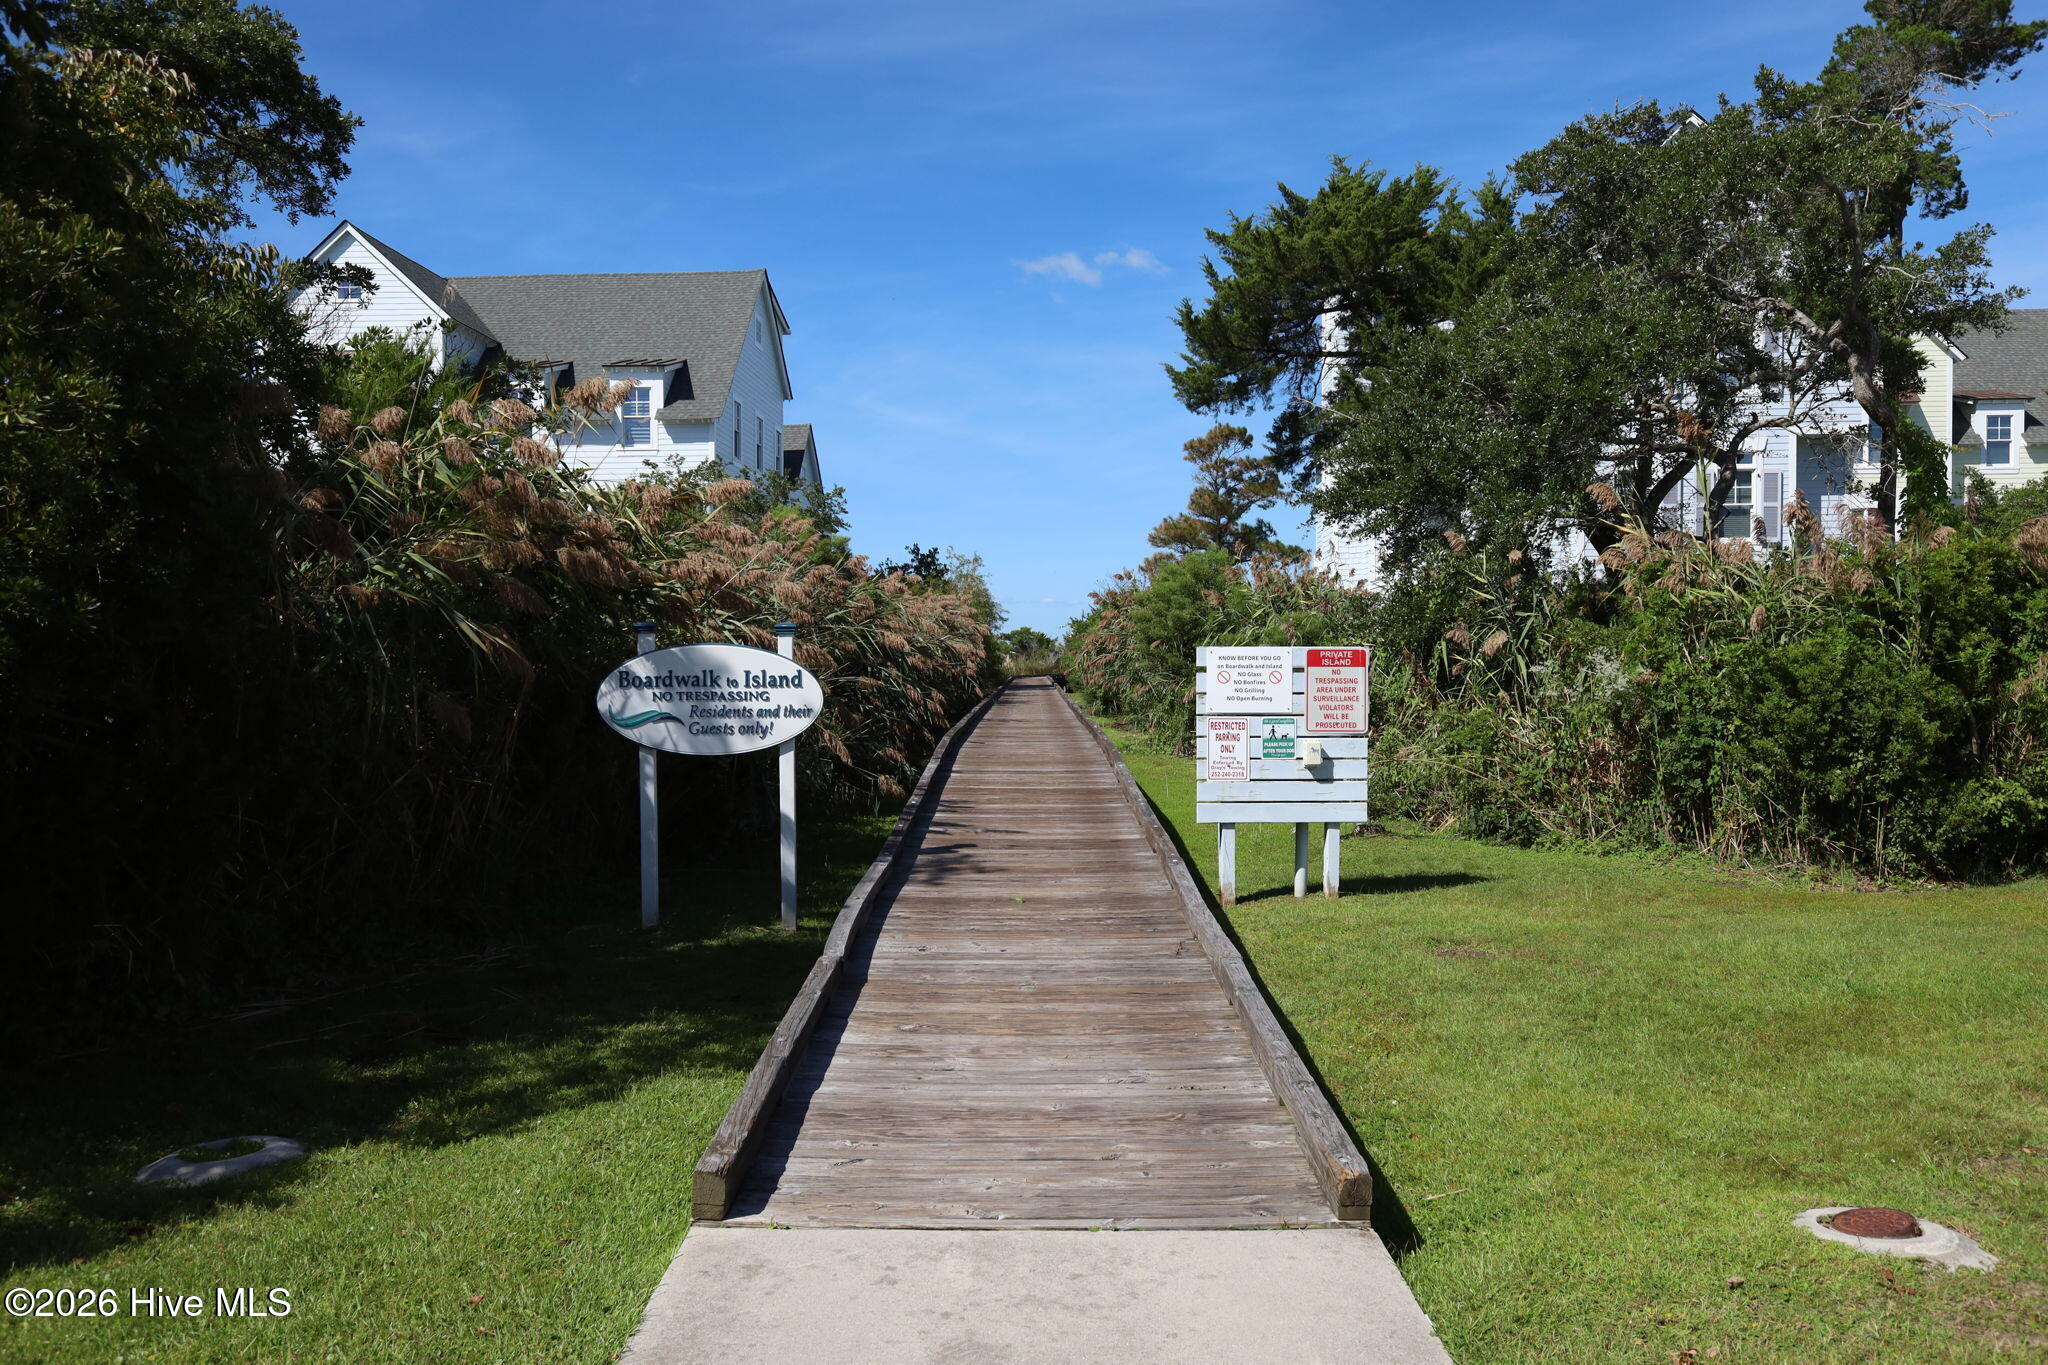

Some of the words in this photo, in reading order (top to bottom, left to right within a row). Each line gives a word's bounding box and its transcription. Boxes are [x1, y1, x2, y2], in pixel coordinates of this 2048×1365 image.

[618, 670, 720, 689] Boardwalk
[726, 677, 738, 689] to
[743, 670, 803, 688] Island
[652, 691, 672, 702] NO
[676, 691, 770, 702] TRESPASSING
[689, 704, 753, 718] Residents
[756, 705, 780, 718] and
[784, 704, 813, 718] their
[688, 722, 735, 736] Guests
[738, 721, 774, 739] only!
[1211, 722, 1245, 730] RESTRICTED
[1216, 733, 1240, 741] PARKING
[1220, 745, 1235, 753] ONLY
